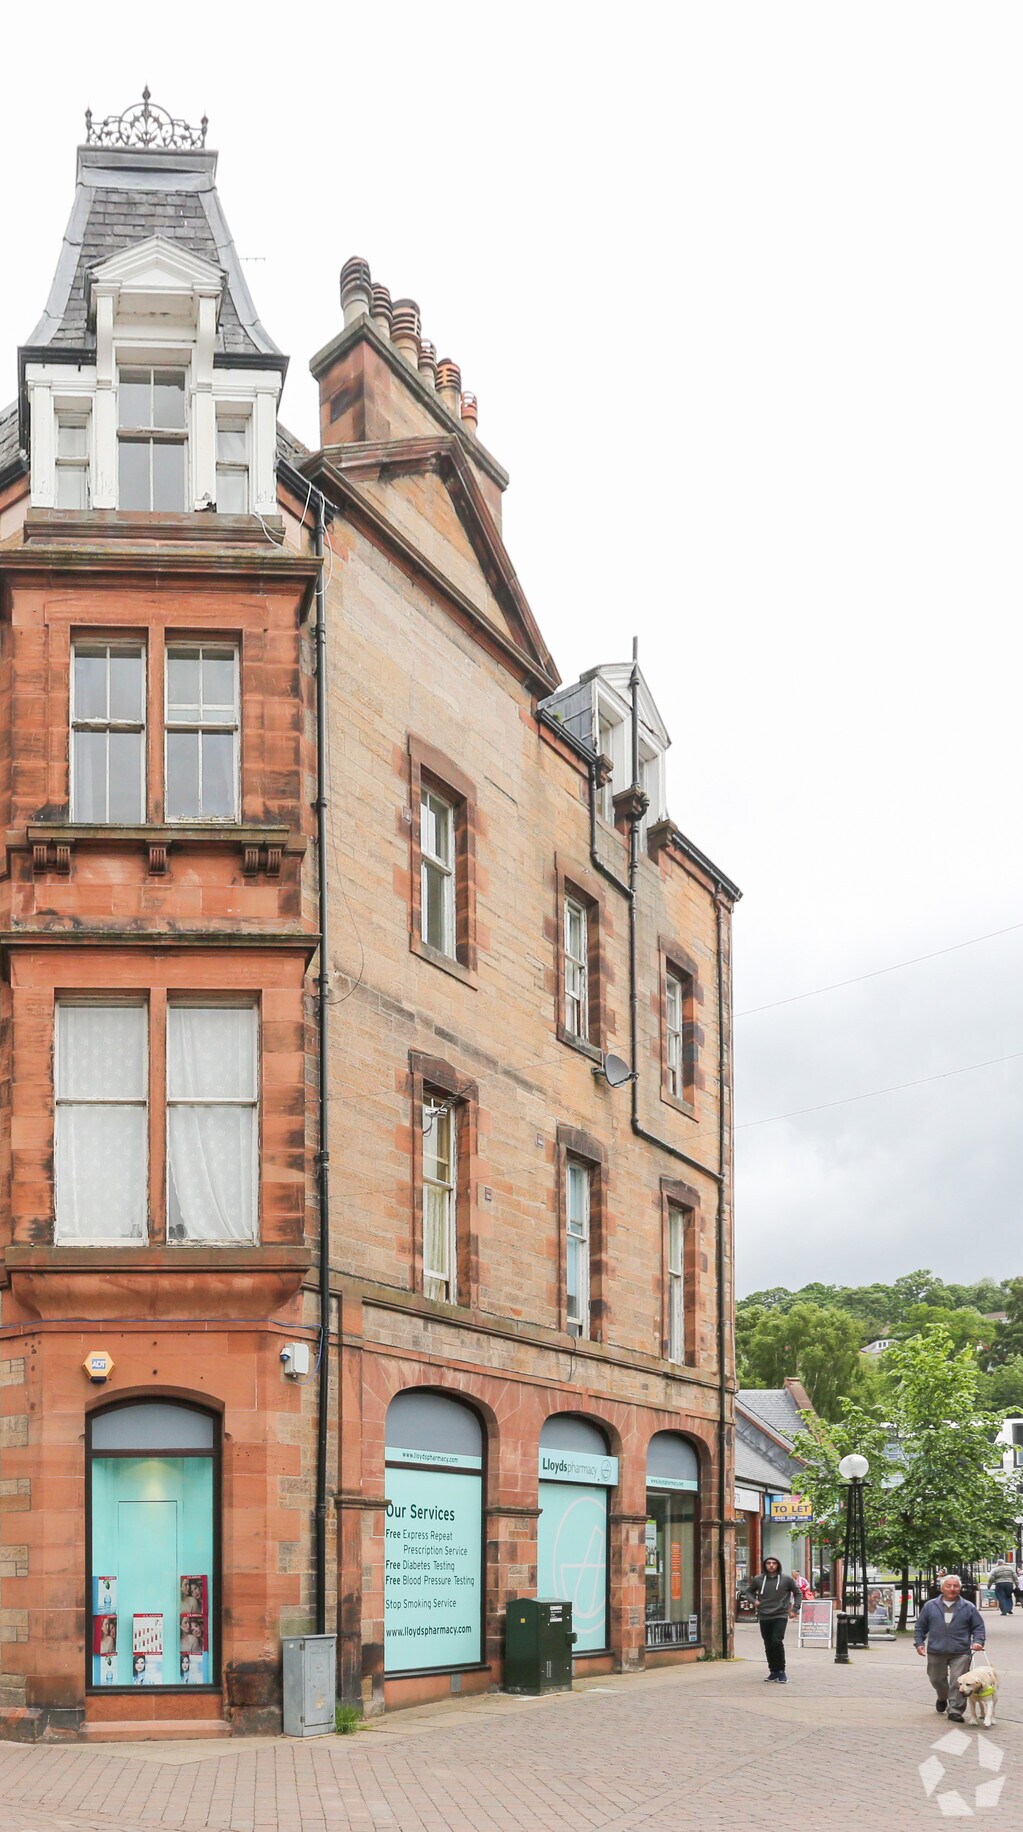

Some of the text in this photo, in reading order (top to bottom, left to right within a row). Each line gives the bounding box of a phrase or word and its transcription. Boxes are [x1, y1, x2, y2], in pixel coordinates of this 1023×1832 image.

[92, 1360, 106, 1369] ADT
[402, 1452, 458, 1463] www.lloydspharmacy.com
[542, 1457, 598, 1478] Lloydspharmacy
[386, 1503, 455, 1521] Our Services
[774, 1505, 809, 1513] TO LET
[385, 1529, 453, 1542] Free Express Repeat
[403, 1544, 468, 1556] Prescription Service
[385, 1560, 455, 1572] Free Diabetes Testing
[385, 1575, 475, 1588] Free Blood Pressure Testing
[385, 1598, 457, 1610] Stop Smoking Service
[386, 1625, 472, 1638] www.lloydspharmacy.com
